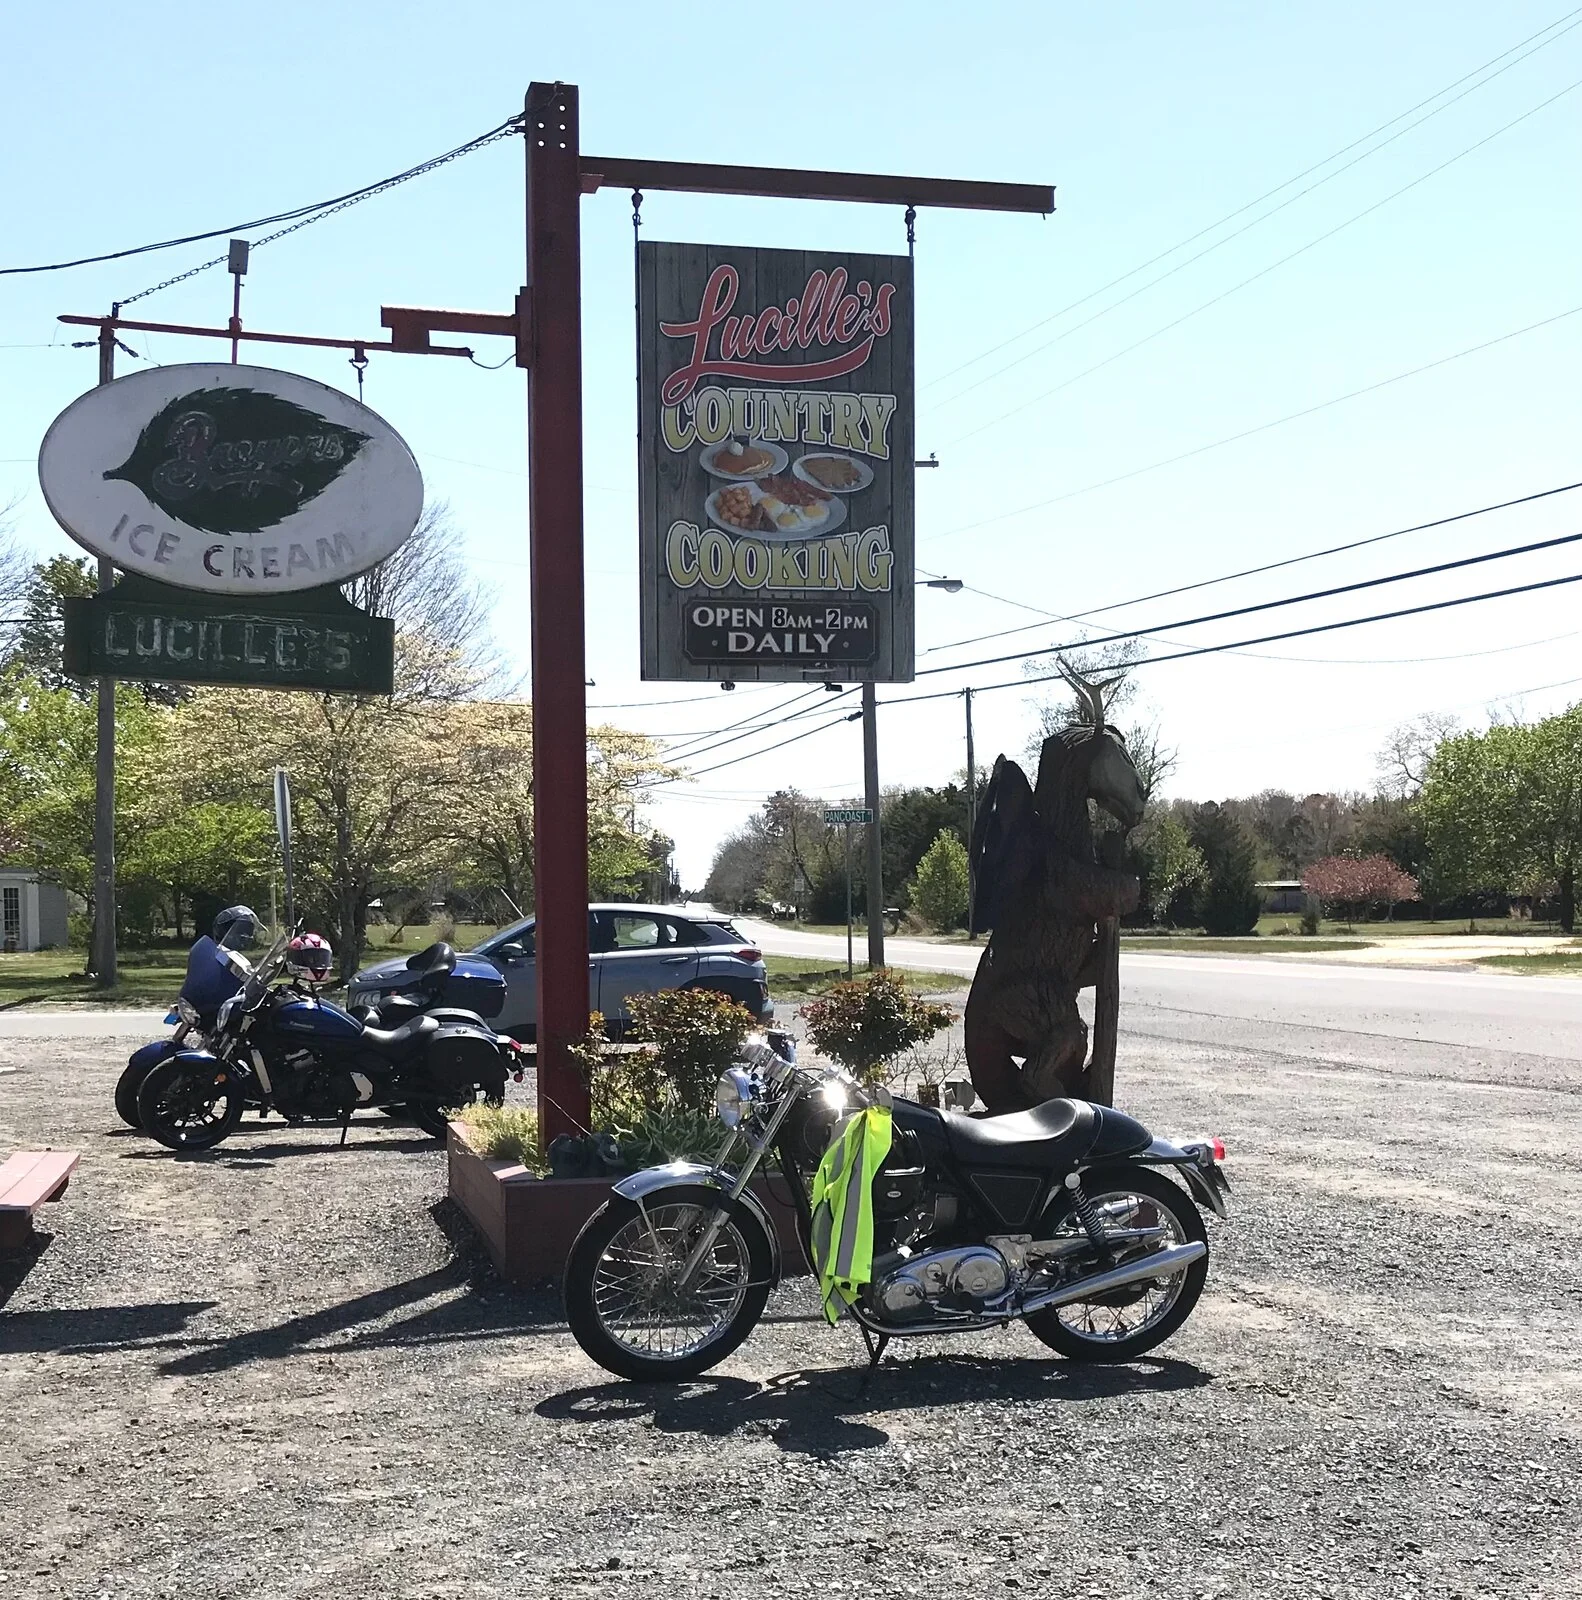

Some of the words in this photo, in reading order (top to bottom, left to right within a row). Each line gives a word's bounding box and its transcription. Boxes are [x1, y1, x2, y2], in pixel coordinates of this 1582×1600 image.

[660, 264, 896, 407] Lucille's
[661, 386, 897, 460] COUNTRY
[109, 513, 181, 565] ICE
[203, 531, 357, 579] CREAM
[666, 520, 893, 592] COOKING
[692, 606, 764, 628] OPEN
[728, 631, 836, 653] DAILY
[824, 811, 866, 822] PANCOAST
